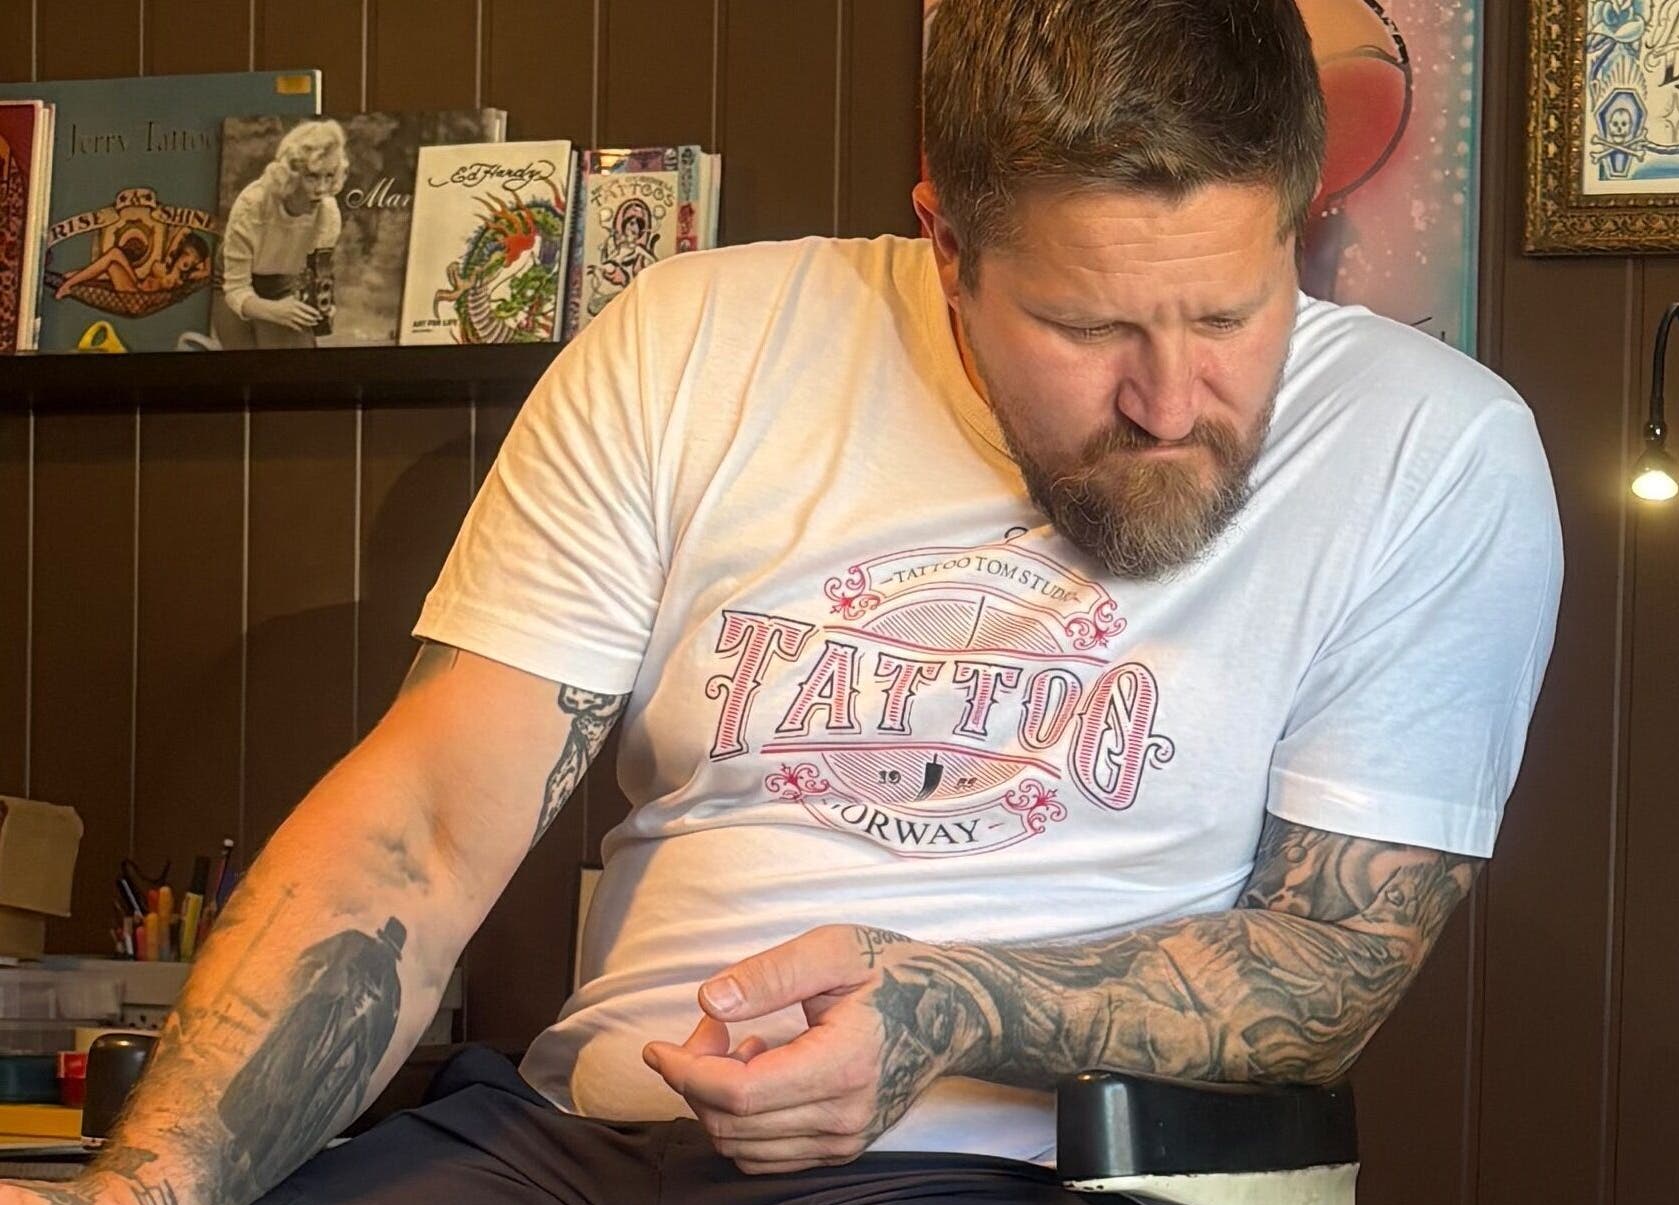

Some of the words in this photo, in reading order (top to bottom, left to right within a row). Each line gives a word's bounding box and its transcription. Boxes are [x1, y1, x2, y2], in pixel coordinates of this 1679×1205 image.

[52, 212, 105, 240] RISE
[976, 556, 1017, 579] TOM
[705, 610, 1175, 811] TATTOO
[832, 804, 981, 844] ORWAY
